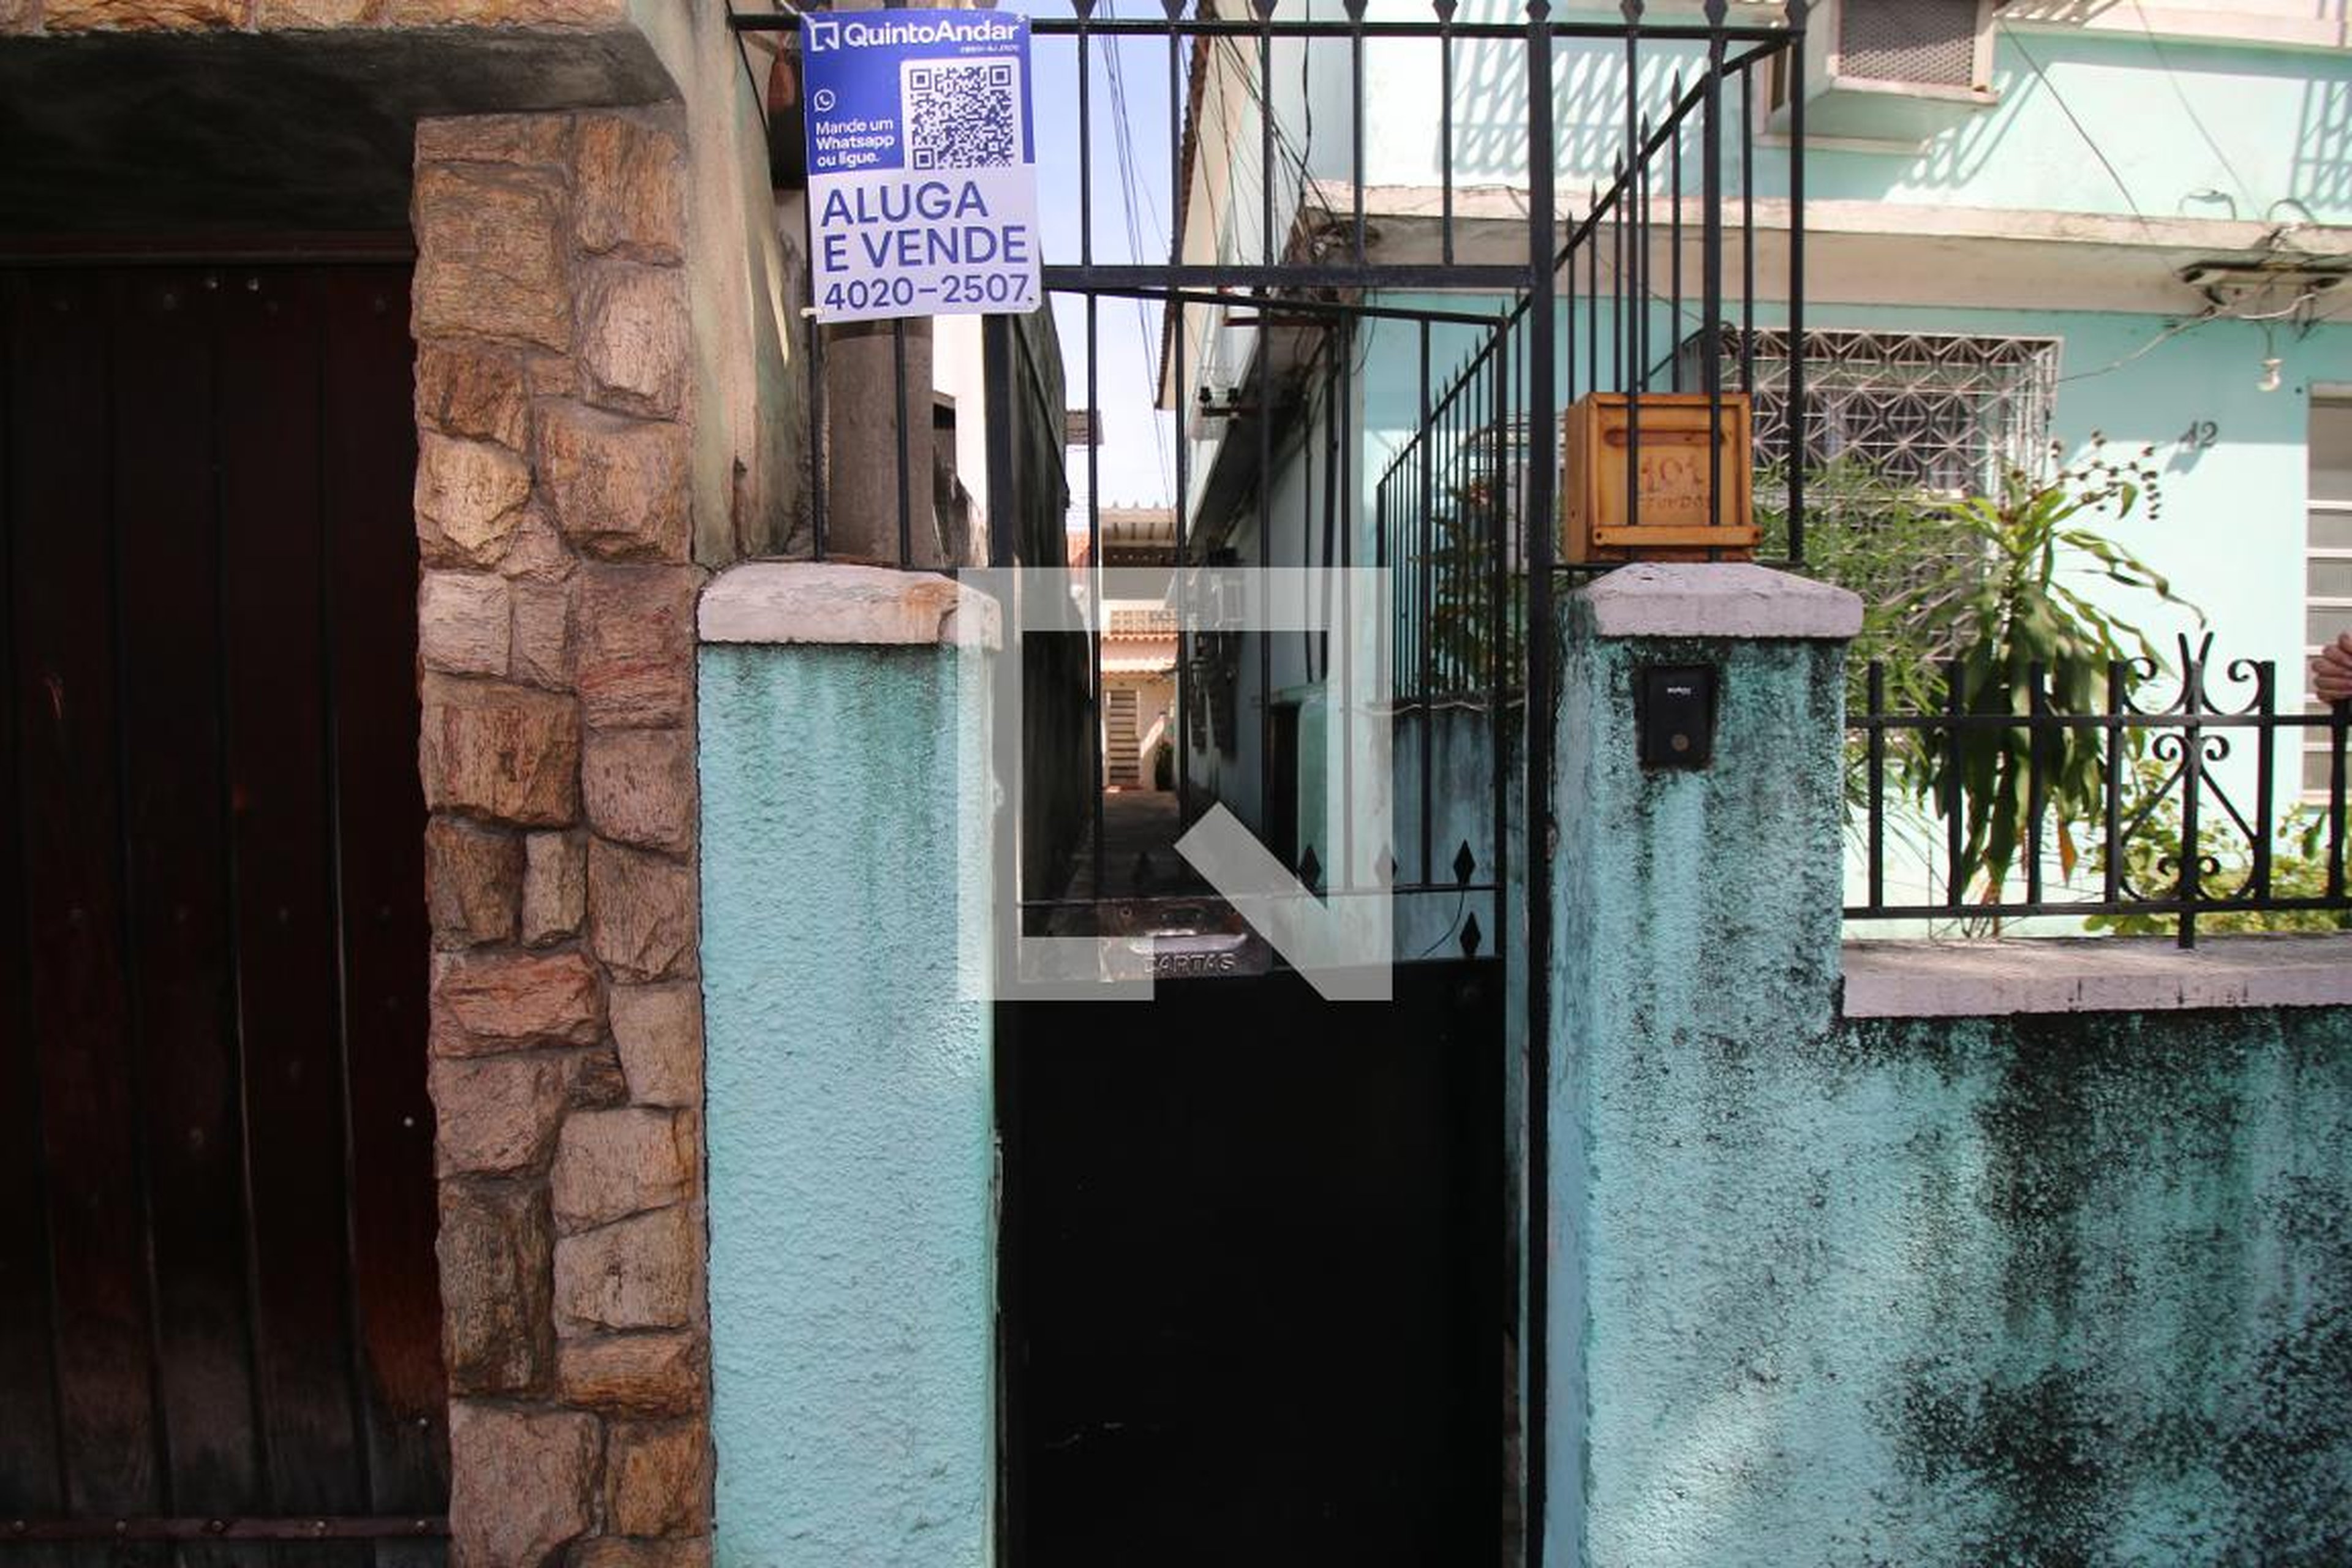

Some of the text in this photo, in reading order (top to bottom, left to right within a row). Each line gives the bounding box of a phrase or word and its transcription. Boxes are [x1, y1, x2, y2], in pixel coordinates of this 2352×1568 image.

[844, 20, 1019, 47] QuintoAndar
[815, 118, 894, 135] Mande um
[816, 134, 895, 151] Whatsapp
[816, 154, 835, 167] ou
[821, 181, 989, 227] ALUGA
[824, 225, 1028, 272] E VENDE
[824, 274, 1030, 311] 4020-2507
